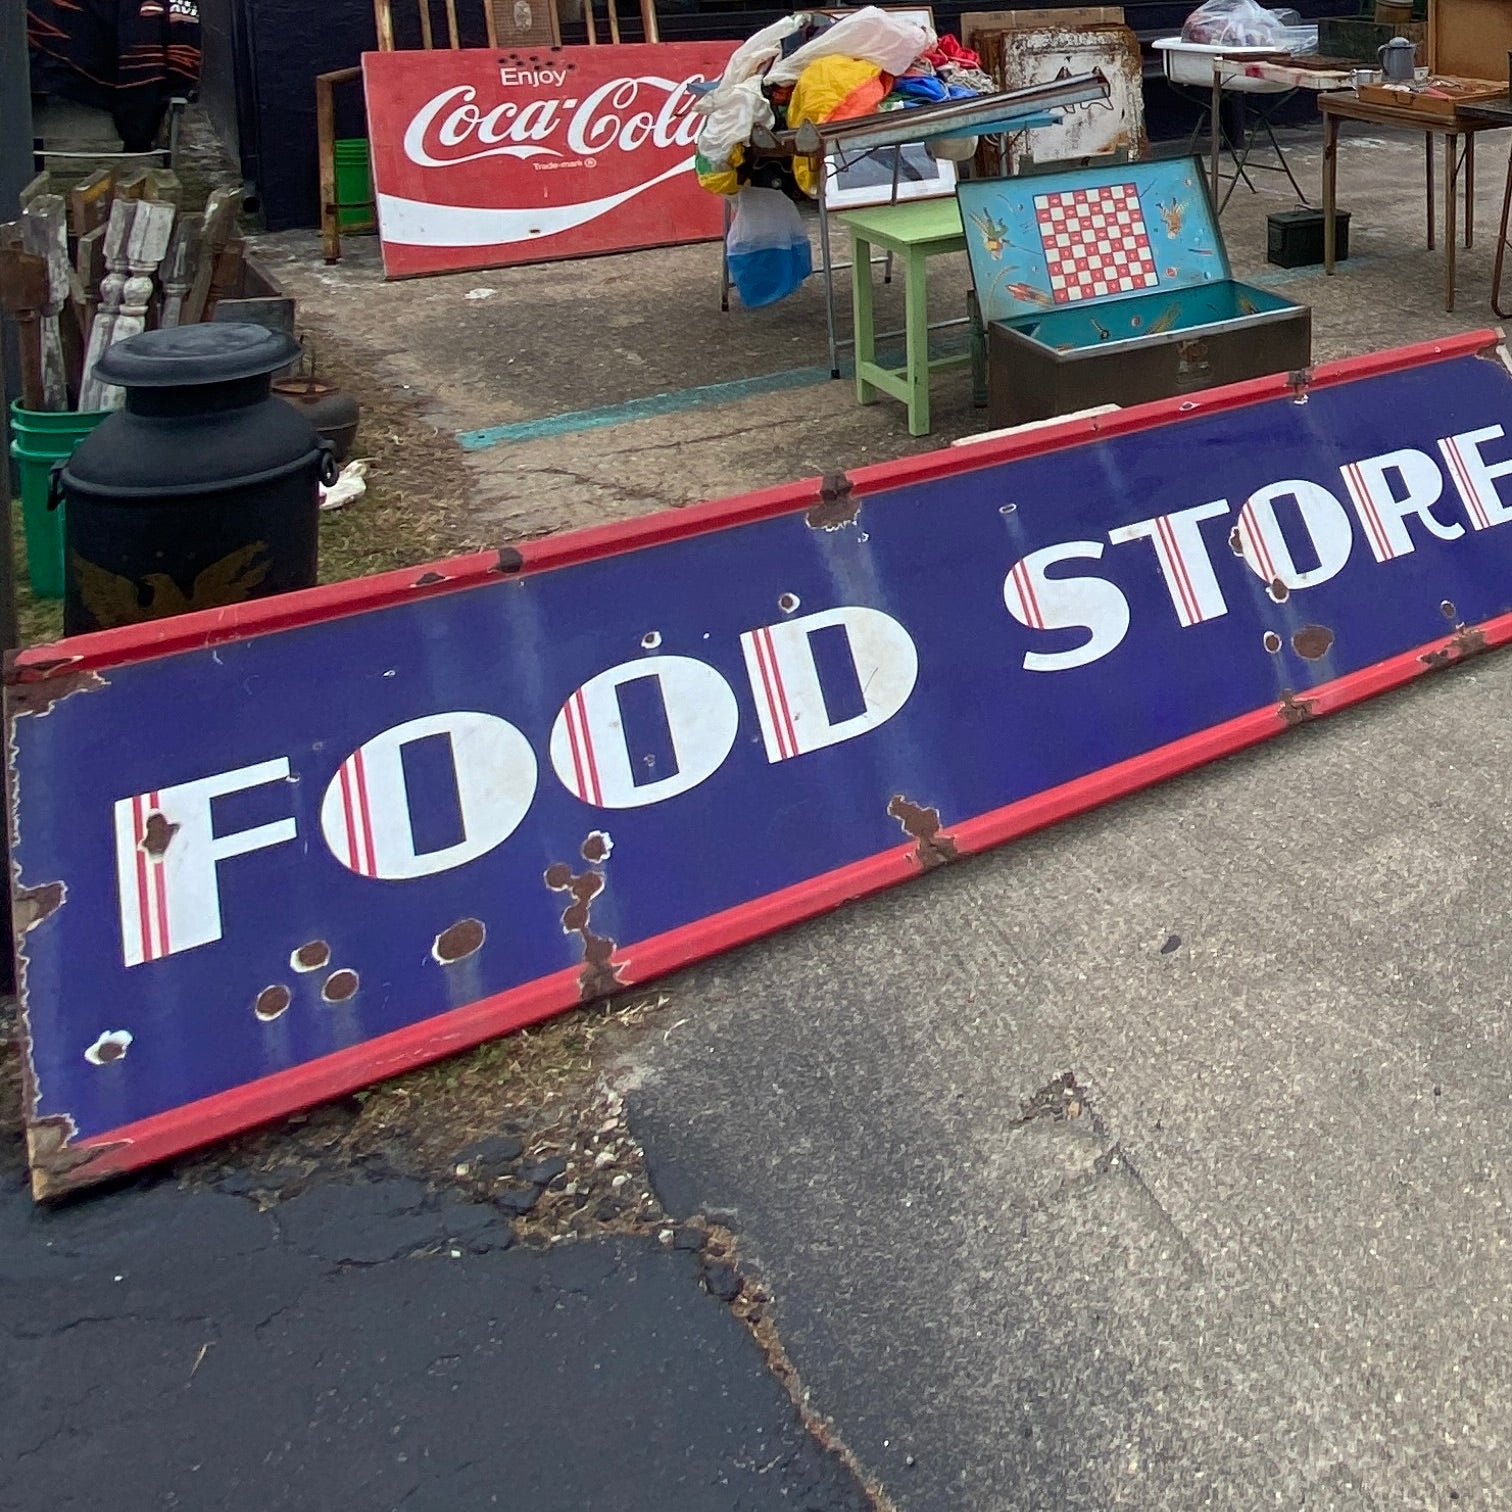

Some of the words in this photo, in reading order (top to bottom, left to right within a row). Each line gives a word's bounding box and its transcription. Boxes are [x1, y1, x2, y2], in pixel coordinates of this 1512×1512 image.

[500, 67, 567, 87] Enjoy
[404, 74, 705, 167] Coca-Cola
[533, 160, 583, 171] Trade-mark
[112, 603, 920, 970] FOOD
